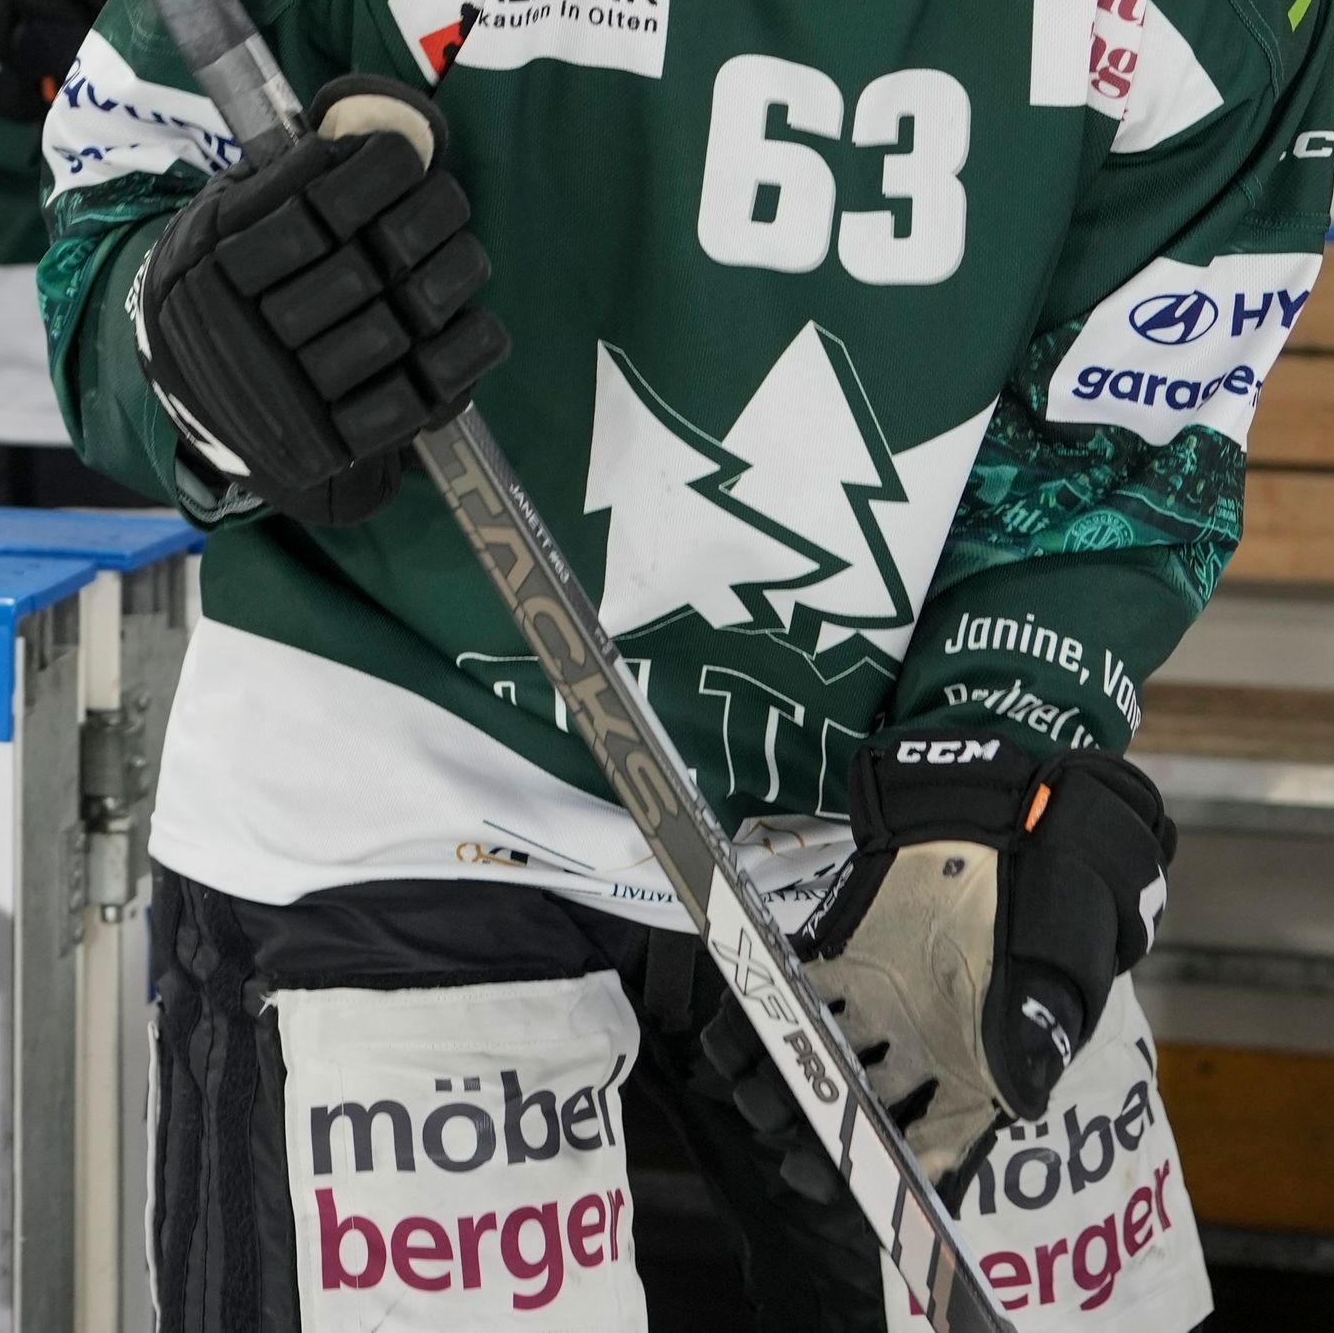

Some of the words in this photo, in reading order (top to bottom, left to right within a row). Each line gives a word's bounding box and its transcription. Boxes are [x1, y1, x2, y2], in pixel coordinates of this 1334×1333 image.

[588, 5, 659, 33] Olten
[697, 53, 972, 286] 63
[508, 482, 553, 549] JANETT
[944, 612, 1090, 686] Janine,
[896, 739, 1001, 765] CCM
[782, 1028, 841, 1106] PRO
[310, 1053, 628, 1175] möbel
[314, 1187, 625, 1311] berger
[909, 1158, 1172, 1313] erger
